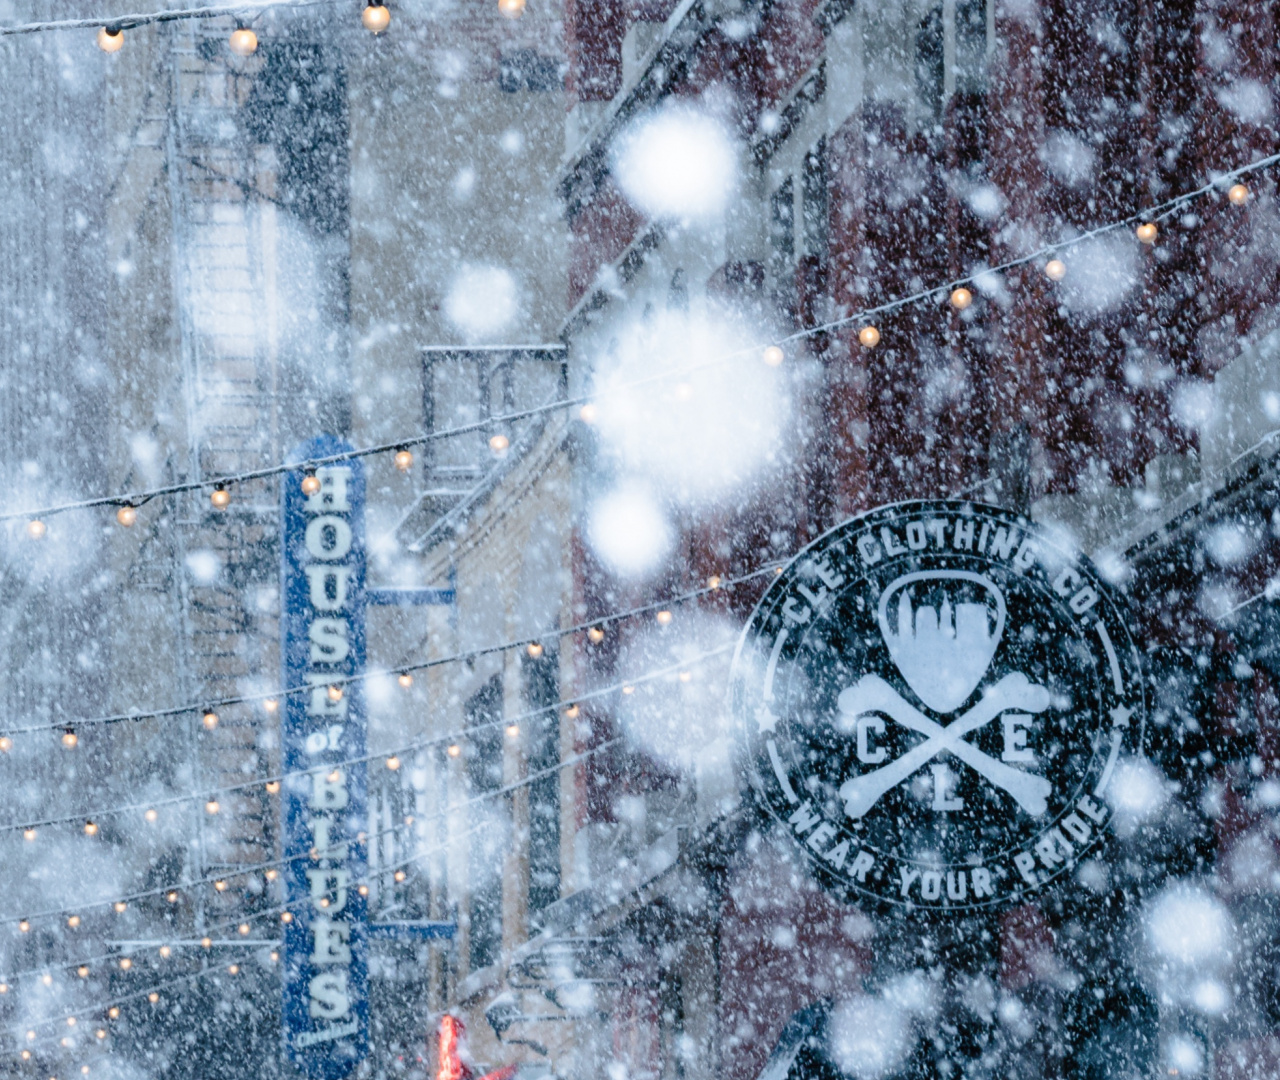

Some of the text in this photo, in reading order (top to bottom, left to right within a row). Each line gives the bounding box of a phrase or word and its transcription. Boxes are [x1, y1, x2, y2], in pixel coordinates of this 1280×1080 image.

[304, 466, 352, 716] HOUSE
[781, 520, 1098, 624] CLE CLOTHING CO.
[305, 725, 344, 754] of
[306, 768, 351, 1018] BLUES
[788, 795, 1108, 901] WEAR YOUR PRIDE
